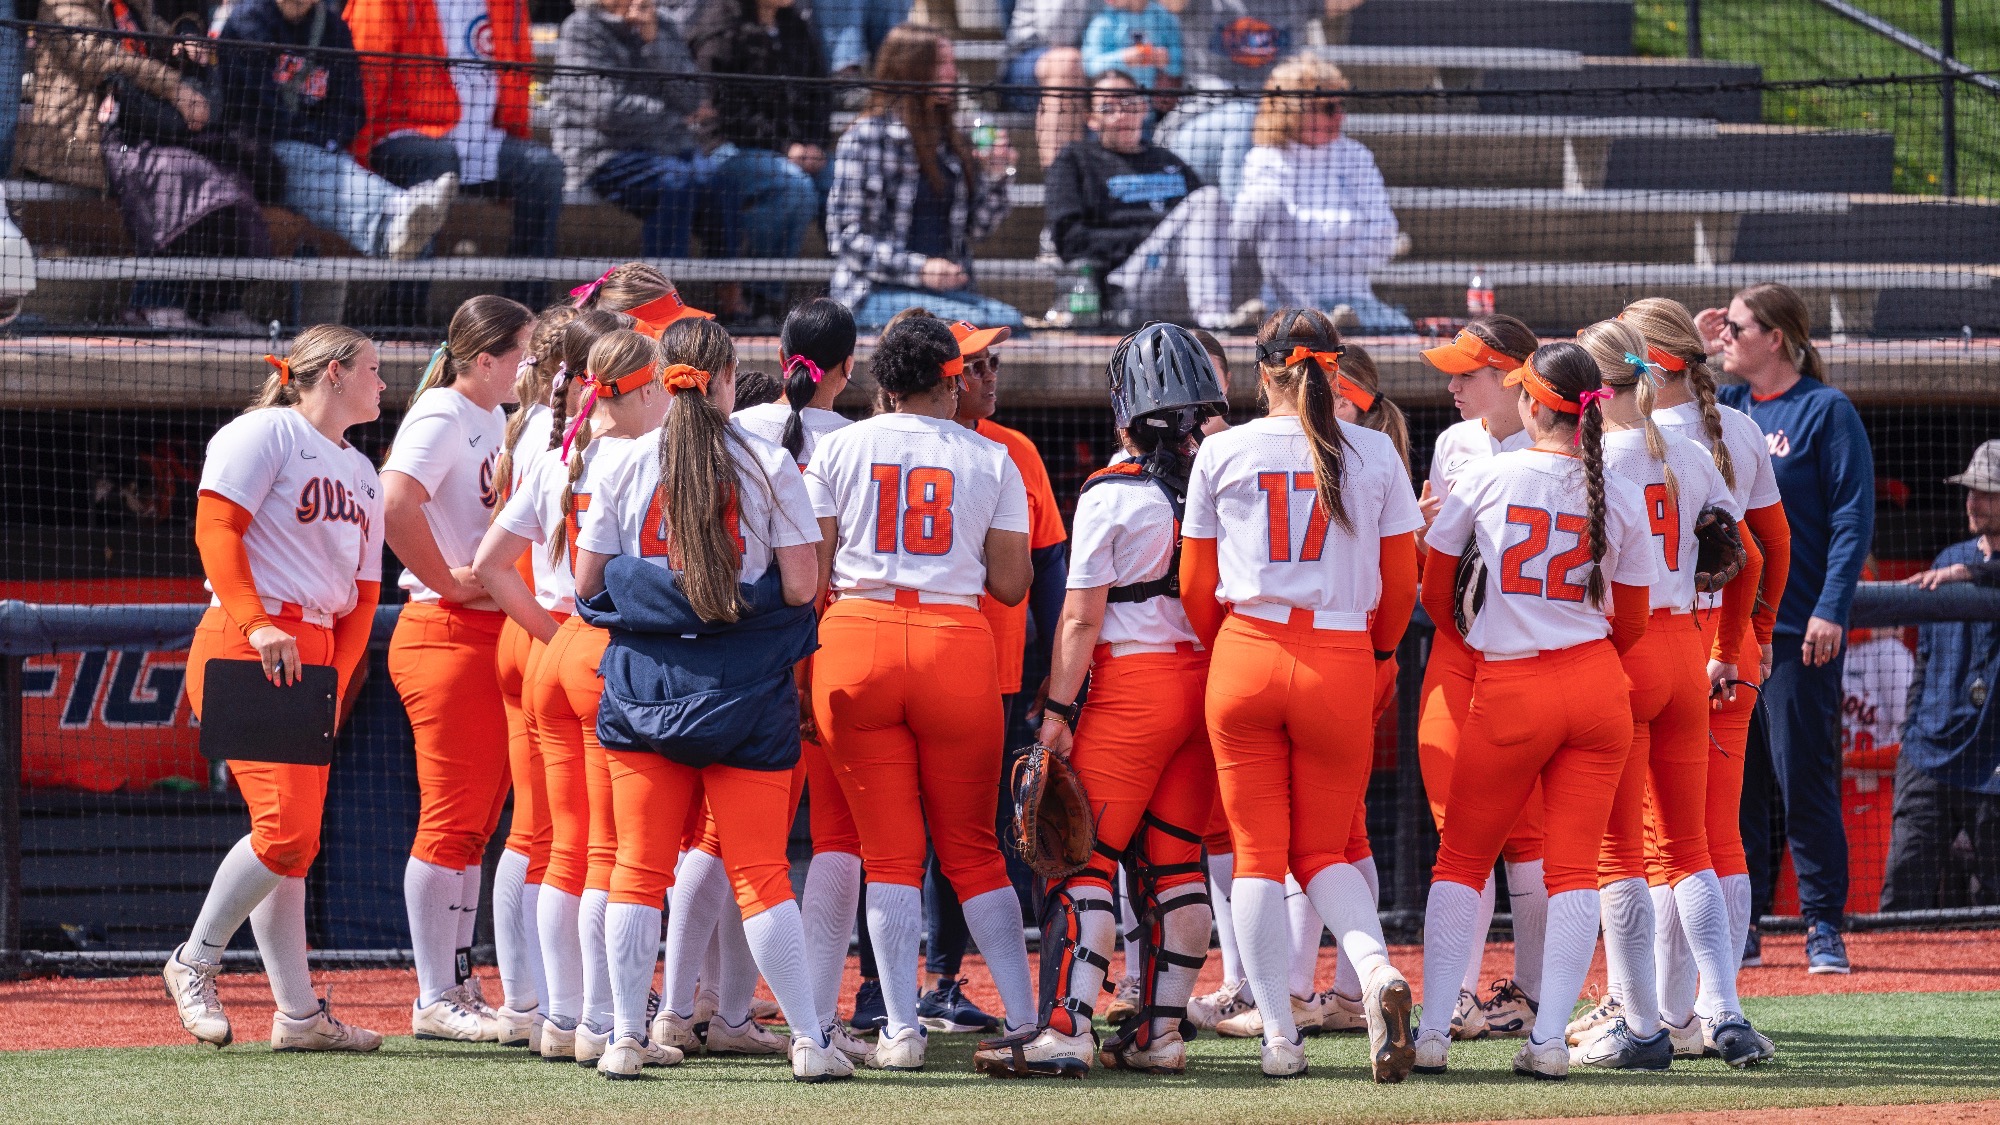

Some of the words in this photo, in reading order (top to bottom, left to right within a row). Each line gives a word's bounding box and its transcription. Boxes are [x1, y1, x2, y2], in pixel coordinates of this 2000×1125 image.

[871, 463, 955, 556] 18
[1258, 471, 1333, 563] 17
[1500, 504, 1593, 603] 22
[1644, 483, 1680, 571] 9
